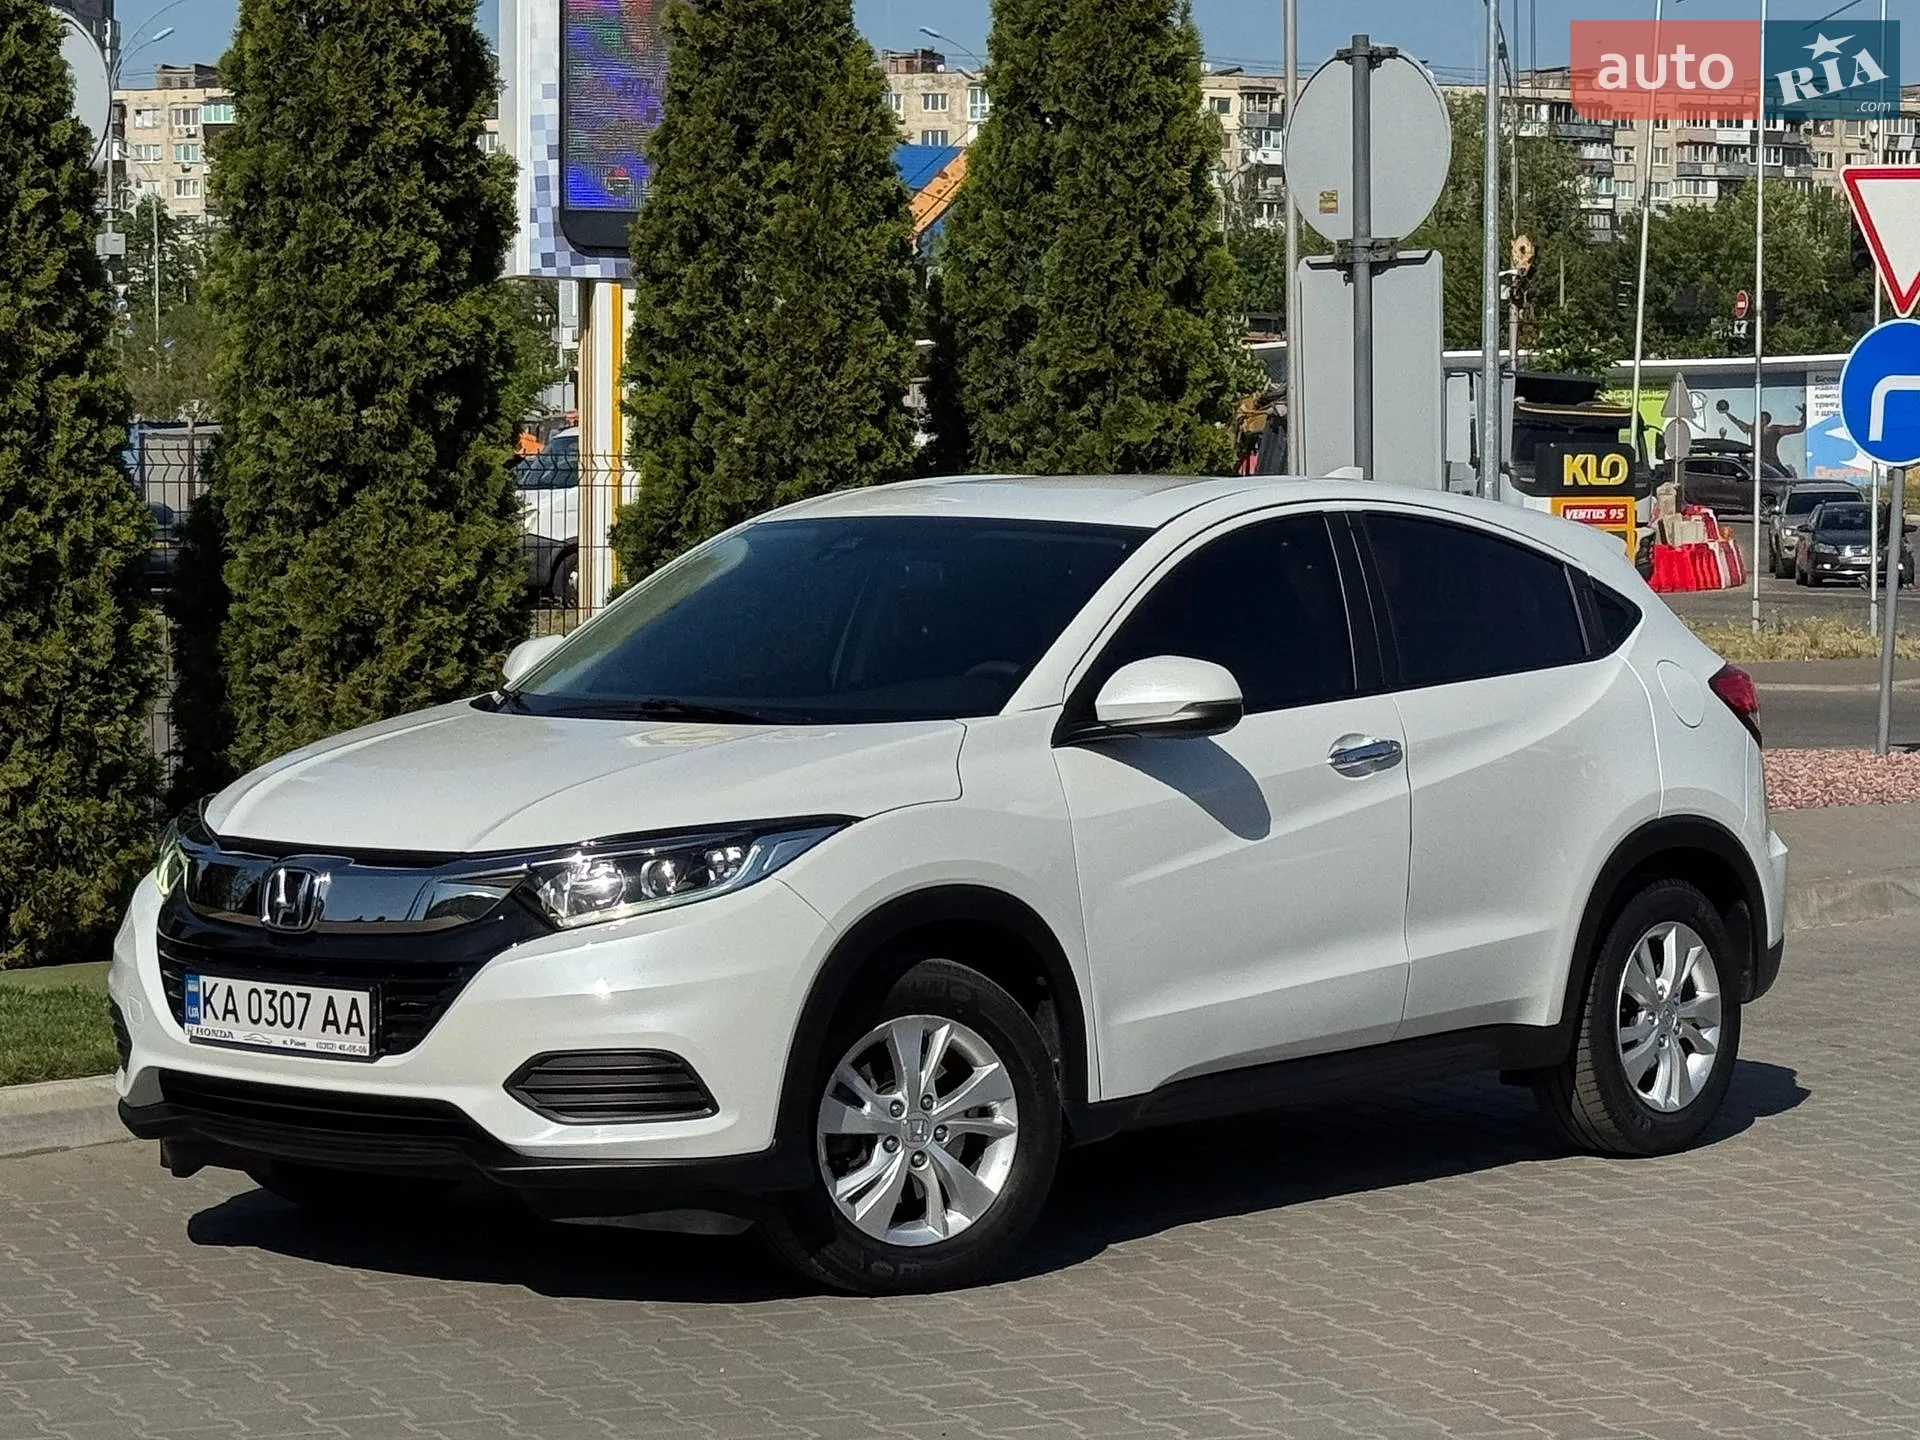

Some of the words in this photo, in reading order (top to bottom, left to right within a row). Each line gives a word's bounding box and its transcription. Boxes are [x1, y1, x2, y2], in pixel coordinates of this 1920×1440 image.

[1563, 453, 1629, 487] KLO
[1565, 508, 1607, 520] VENTUS
[1609, 508, 1625, 519] 95
[202, 981, 240, 1024] KA
[247, 988, 312, 1030] 0307
[321, 995, 366, 1037] AA
[196, 1026, 235, 1040] HONDA
